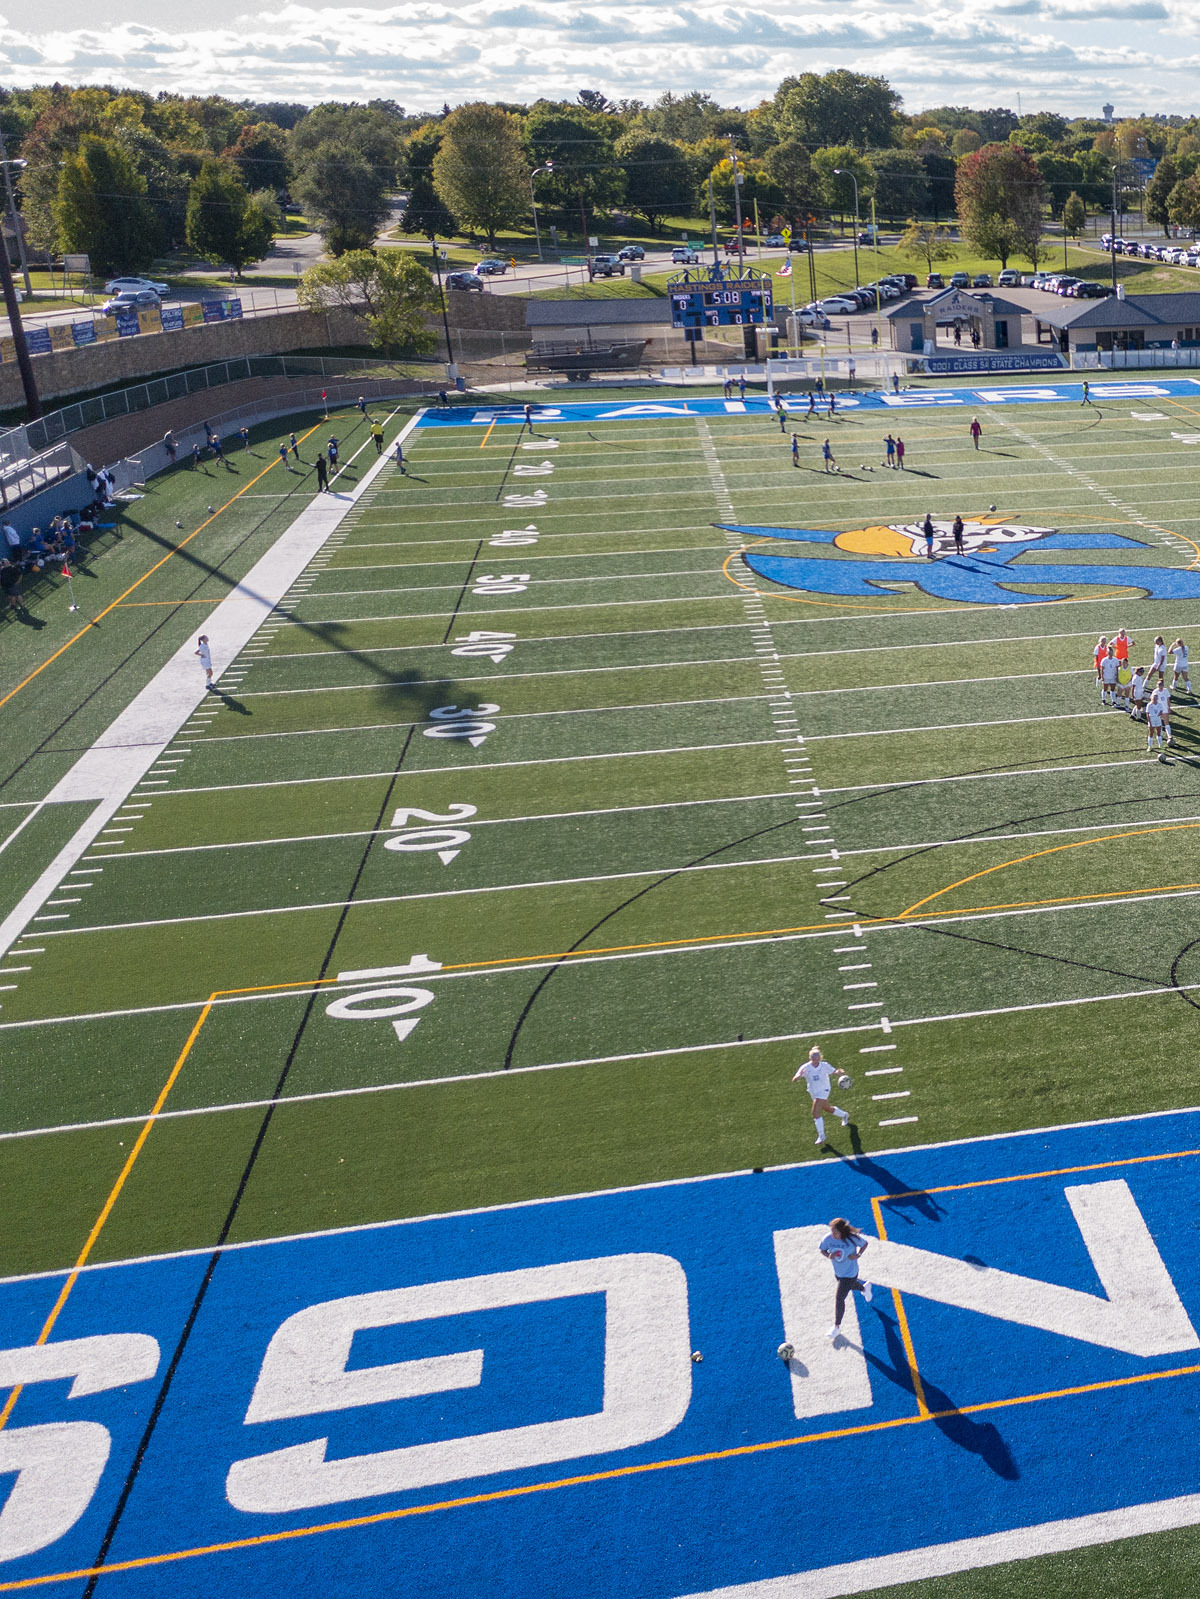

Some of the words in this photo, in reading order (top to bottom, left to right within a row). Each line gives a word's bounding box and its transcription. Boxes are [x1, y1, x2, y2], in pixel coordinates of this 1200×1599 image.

[669, 283, 722, 292] HASTINGS
[713, 291, 740, 304] 5:08
[765, 296, 771, 306] 0
[680, 300, 687, 310] 0
[939, 305, 980, 314] RAIDERS
[712, 315, 719, 326] 0
[736, 314, 743, 324] 0
[953, 361, 978, 370] CLASS
[991, 360, 1013, 369] STATE
[1014, 358, 1058, 368] CHAMPIONS
[512, 464, 555, 476] 20
[502, 493, 548, 507] 30
[488, 530, 540, 546] 40
[472, 574, 531, 595] 50
[451, 631, 517, 656] 40
[423, 703, 500, 738] 30
[383, 803, 478, 851] 20
[325, 954, 443, 1020] 10
